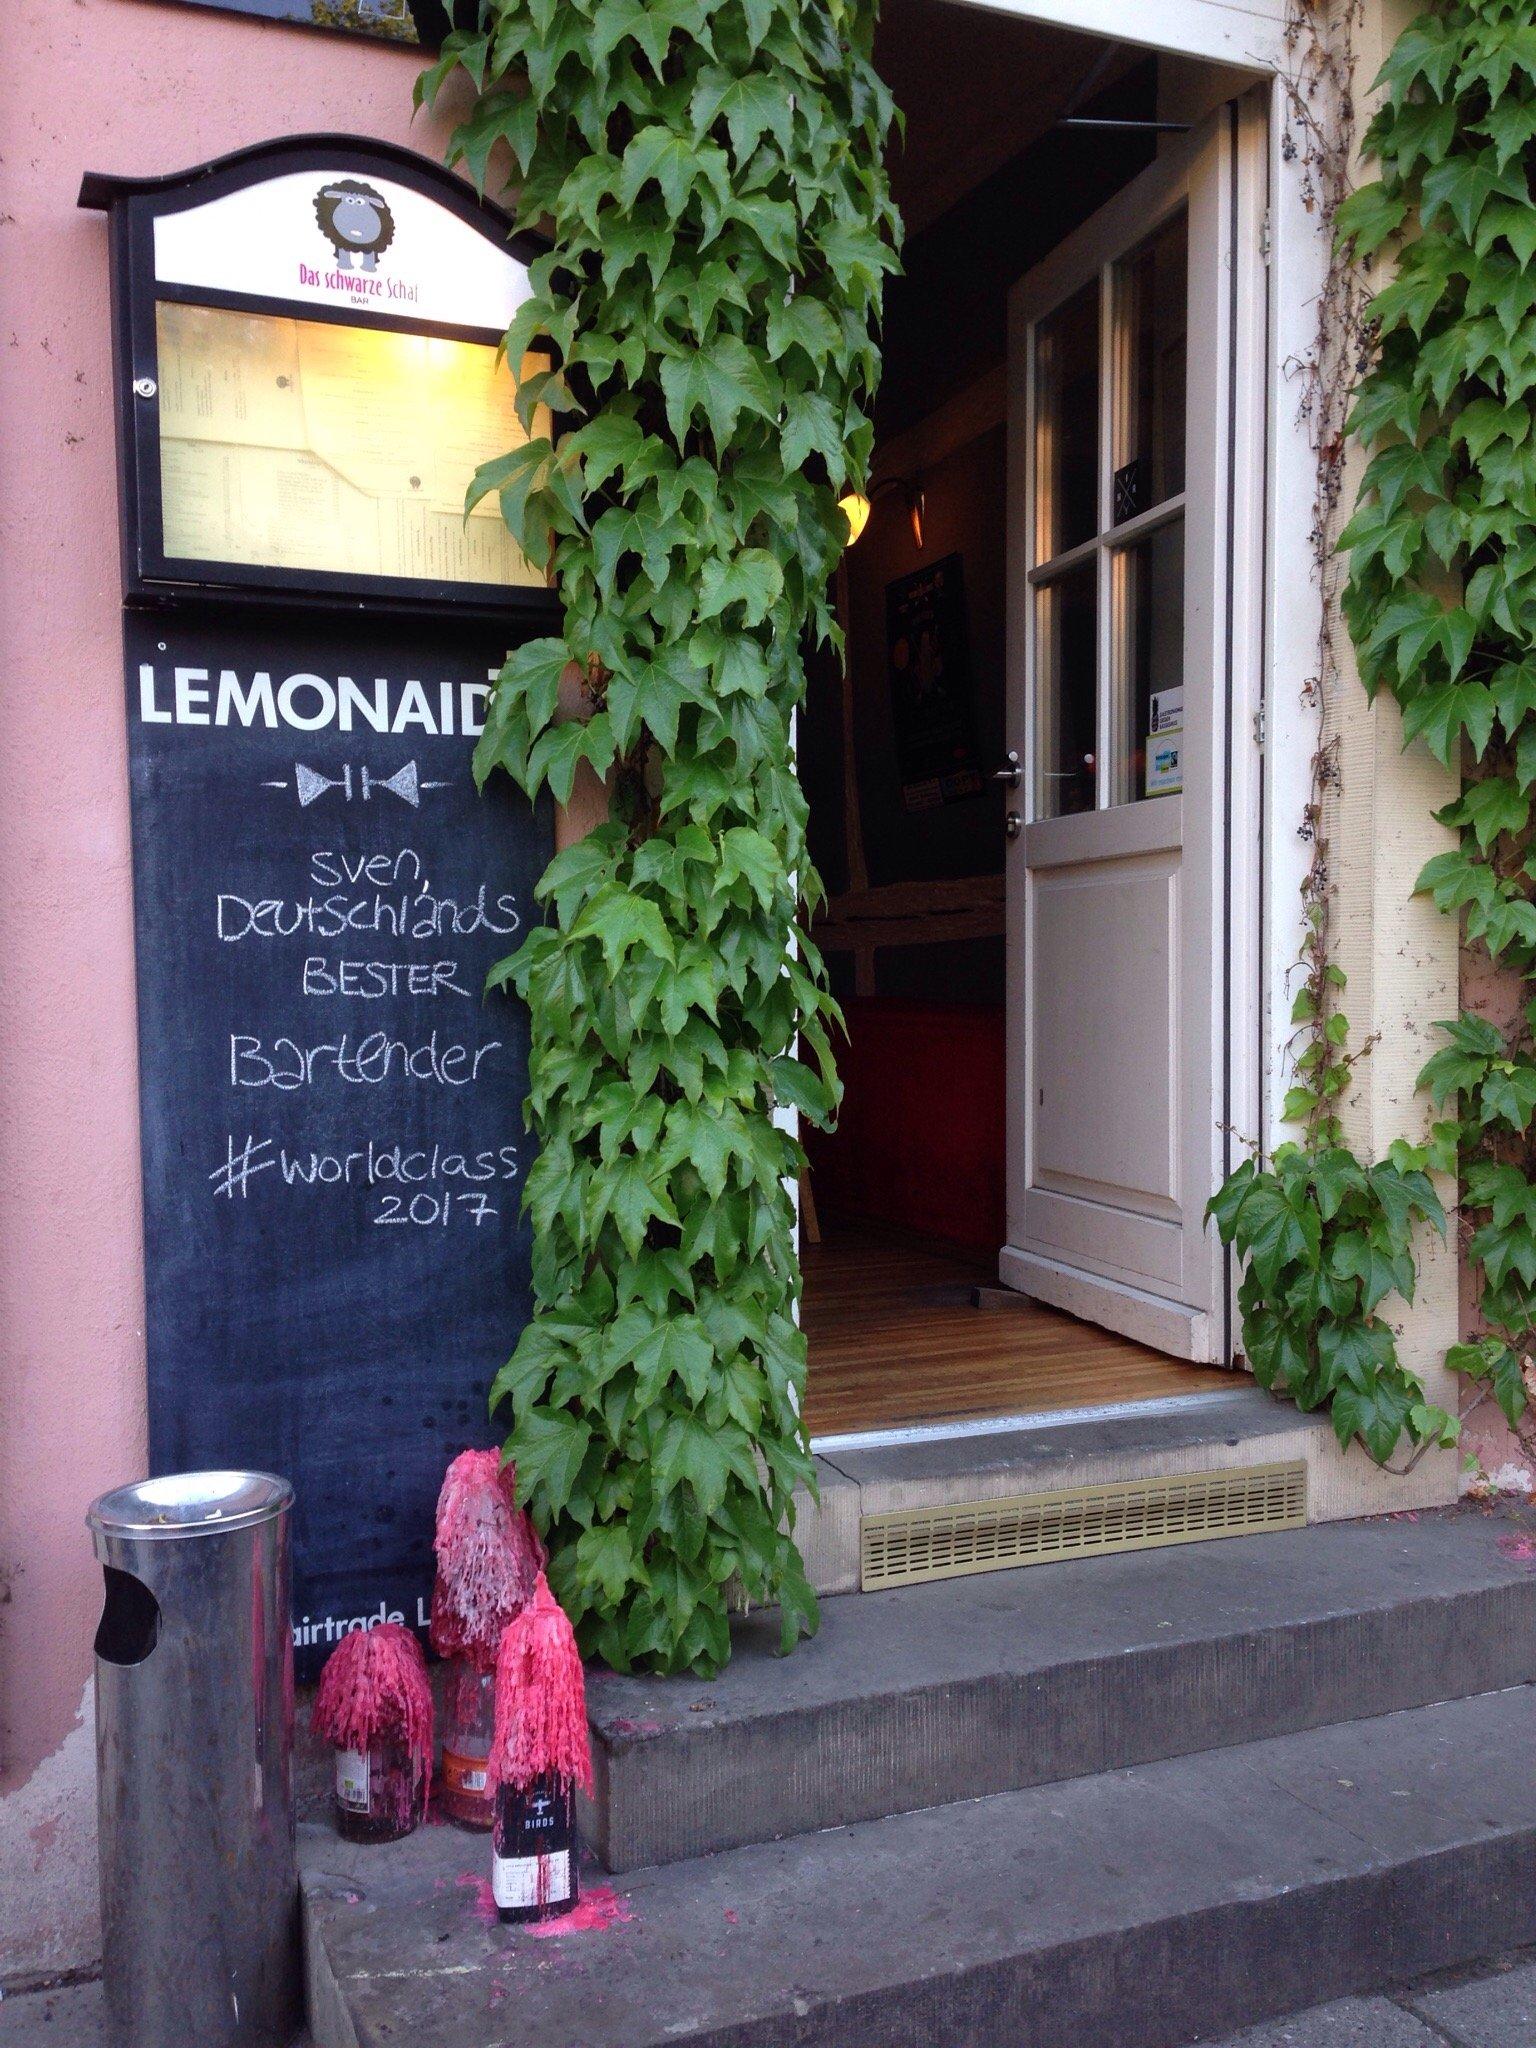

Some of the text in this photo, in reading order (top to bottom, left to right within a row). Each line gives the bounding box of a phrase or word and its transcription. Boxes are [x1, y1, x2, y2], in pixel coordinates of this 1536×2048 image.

[299, 263, 320, 288] Das
[325, 269, 382, 296] schwarze
[303, 956, 472, 998] BESTER
[230, 1030, 502, 1090] Bartender
[373, 1191, 498, 1227] 2017
[293, 1601, 405, 1647] airtrade
[525, 1816, 554, 1830] BIRDS
